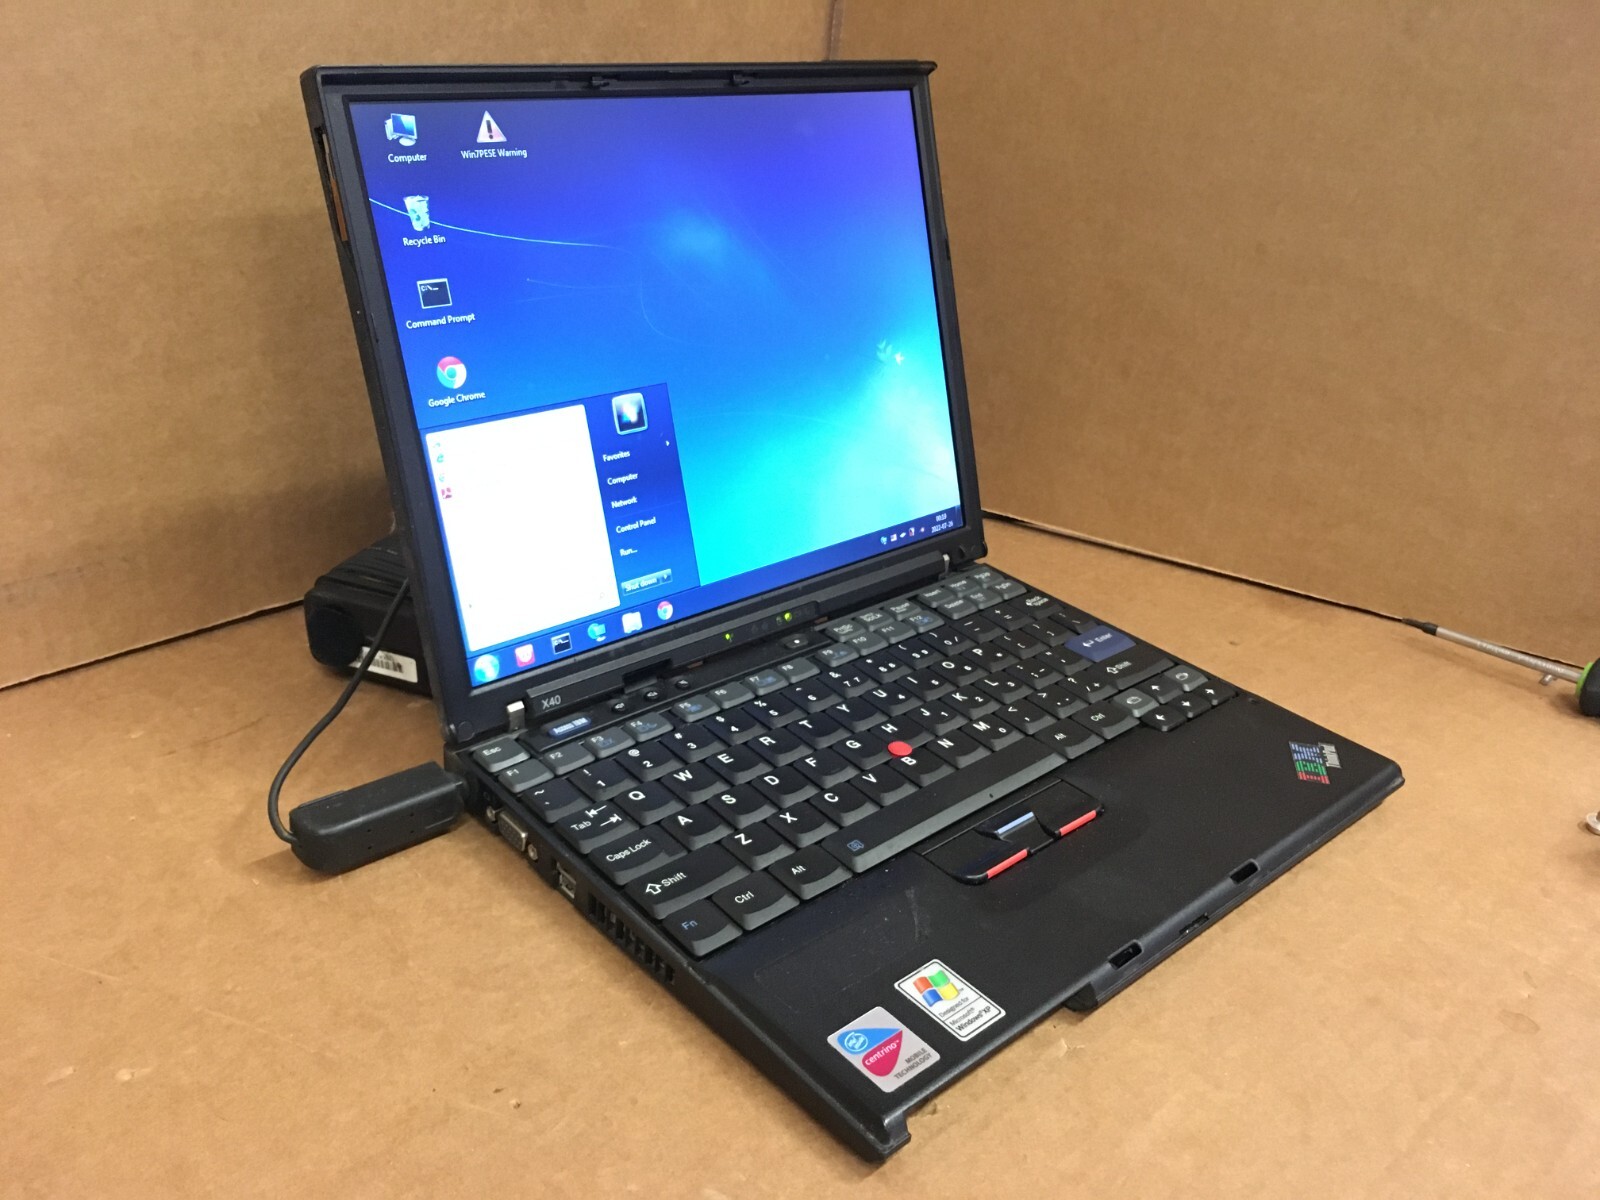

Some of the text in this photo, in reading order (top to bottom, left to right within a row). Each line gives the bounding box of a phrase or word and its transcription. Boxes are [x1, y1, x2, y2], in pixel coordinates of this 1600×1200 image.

[388, 153, 427, 164] Computer
[460, 148, 527, 159] Win7PESE Warning
[403, 234, 446, 248] Recycle Bin
[406, 312, 476, 329] Command Prompt
[428, 391, 486, 408] Google Chrome
[603, 451, 631, 462] Favorites
[607, 473, 638, 486] Computer
[611, 495, 638, 509] Network
[615, 516, 657, 534] Control Panel
[942, 661, 955, 669] O
[873, 689, 887, 698] U
[951, 692, 968, 701] K
[541, 695, 561, 710] X40
[836, 703, 850, 713] Y
[920, 708, 931, 716] J
[798, 719, 813, 729] T
[881, 723, 898, 733] H
[972, 720, 991, 731] M
[759, 736, 776, 746] R
[845, 740, 862, 749] G
[937, 738, 954, 748] N
[482, 746, 502, 756] Esc
[550, 751, 563, 760] F2
[628, 748, 640, 757] @
[643, 760, 653, 768] 2
[717, 753, 734, 764] E
[804, 757, 817, 768] F
[900, 756, 917, 766] B
[506, 768, 520, 776] F1
[673, 769, 693, 781] W
[764, 775, 780, 785] D
[862, 773, 877, 783] V
[628, 790, 646, 801] Q
[721, 794, 737, 805] S
[823, 792, 839, 803] C
[677, 815, 693, 826] A
[779, 812, 798, 823] X
[570, 820, 592, 831] Tab
[734, 833, 752, 846] Z
[606, 839, 652, 863] Caps Lock
[791, 865, 807, 875] Alt
[661, 872, 687, 888] Shift
[734, 890, 755, 905] Ctrl
[681, 919, 699, 931] Fn
[982, 1005, 991, 1014] XP
[905, 1047, 928, 1064] MOBILE
[893, 1052, 932, 1079] TECHNOLOGY
